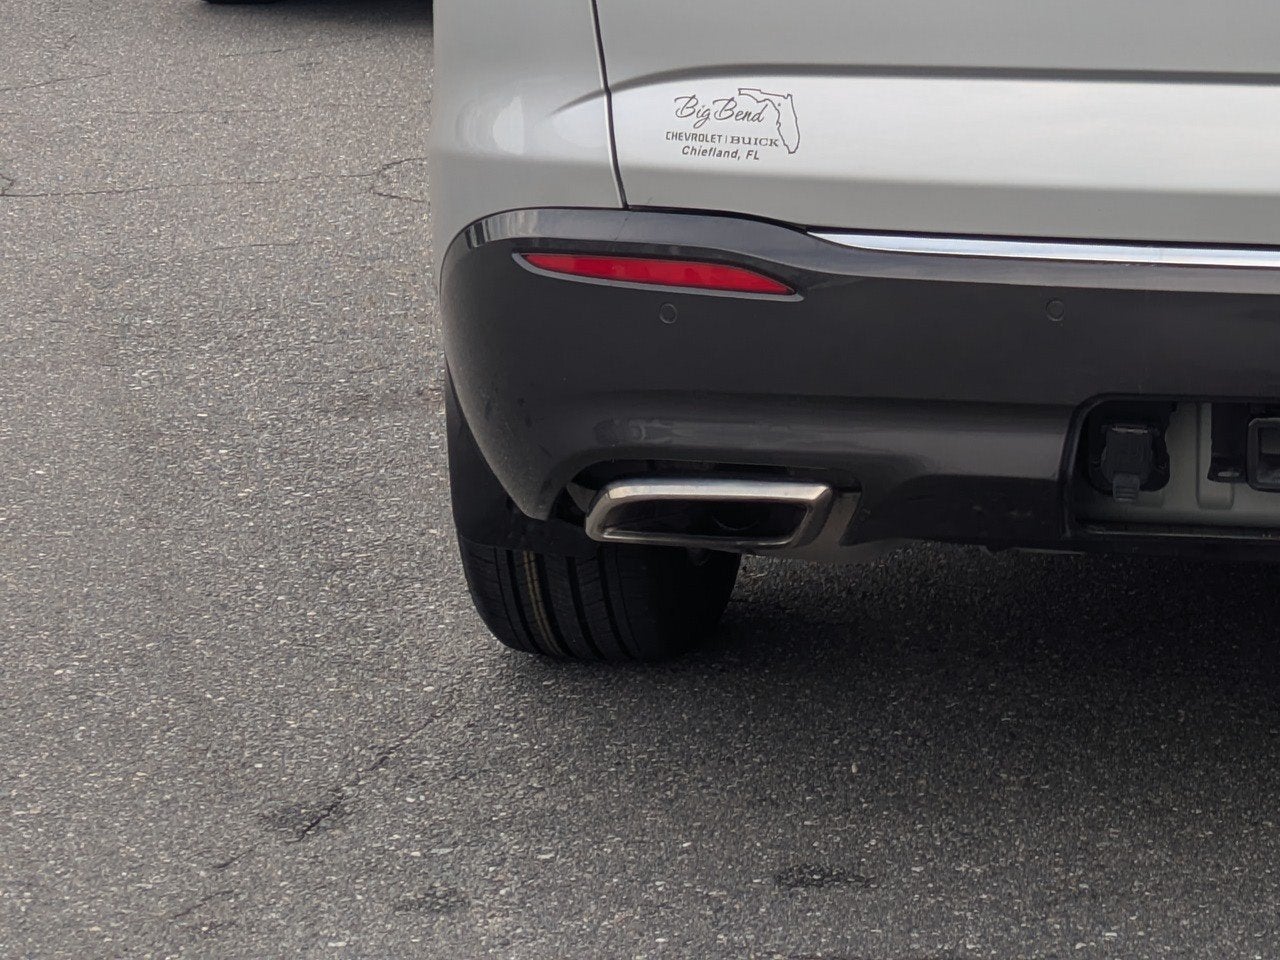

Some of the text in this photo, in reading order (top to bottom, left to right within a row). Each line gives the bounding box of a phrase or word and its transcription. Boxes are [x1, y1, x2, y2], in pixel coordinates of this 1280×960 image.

[674, 94, 769, 129] Big Bend
[665, 131, 780, 148] CHEVROLET BUICK
[681, 145, 760, 161] Chiefland, FL
